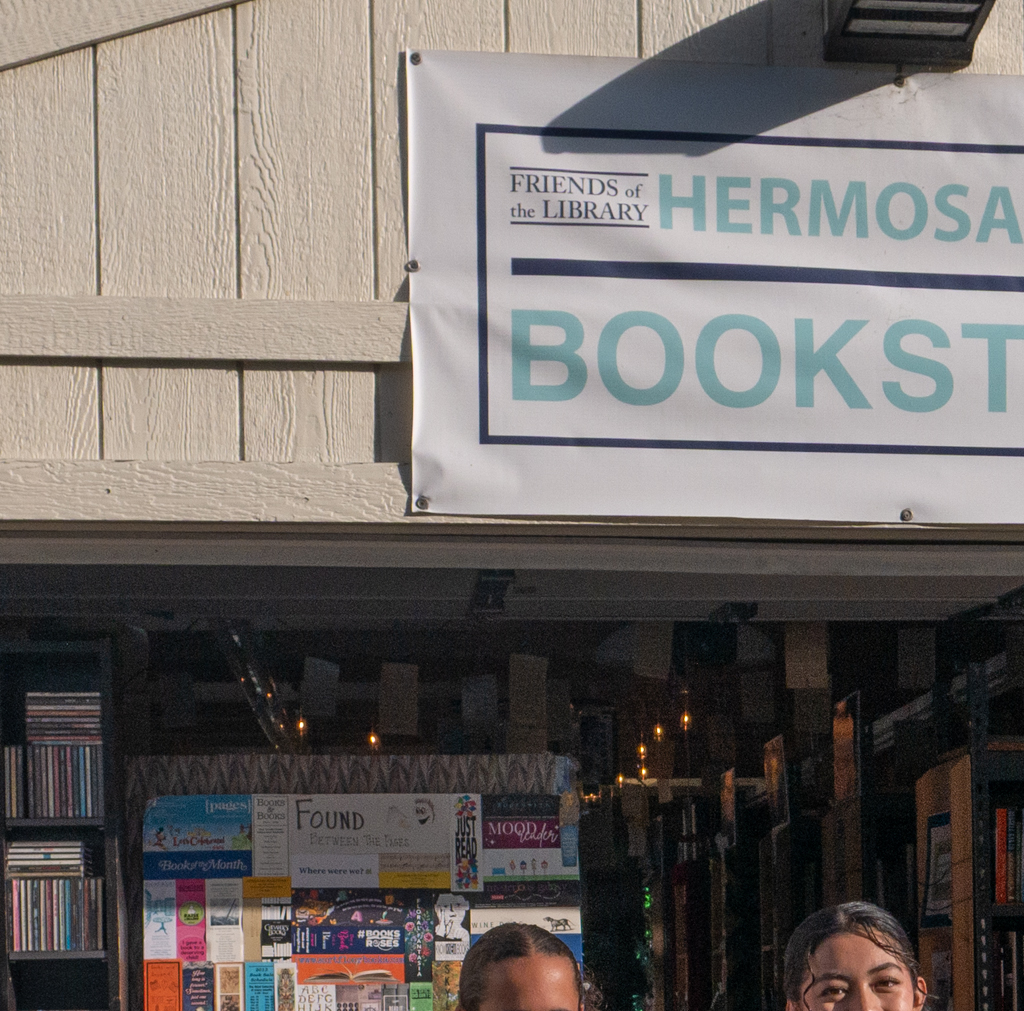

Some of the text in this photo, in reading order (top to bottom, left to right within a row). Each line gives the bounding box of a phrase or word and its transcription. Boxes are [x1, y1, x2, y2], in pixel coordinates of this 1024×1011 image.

[510, 174, 643, 198] FRIENDS of
[511, 199, 648, 221] the LIBRARY
[658, 171, 1023, 246] HERMOSA
[456, 816, 476, 837] JUST
[456, 837, 477, 860] READ
[357, 930, 400, 939] #BOOKS
